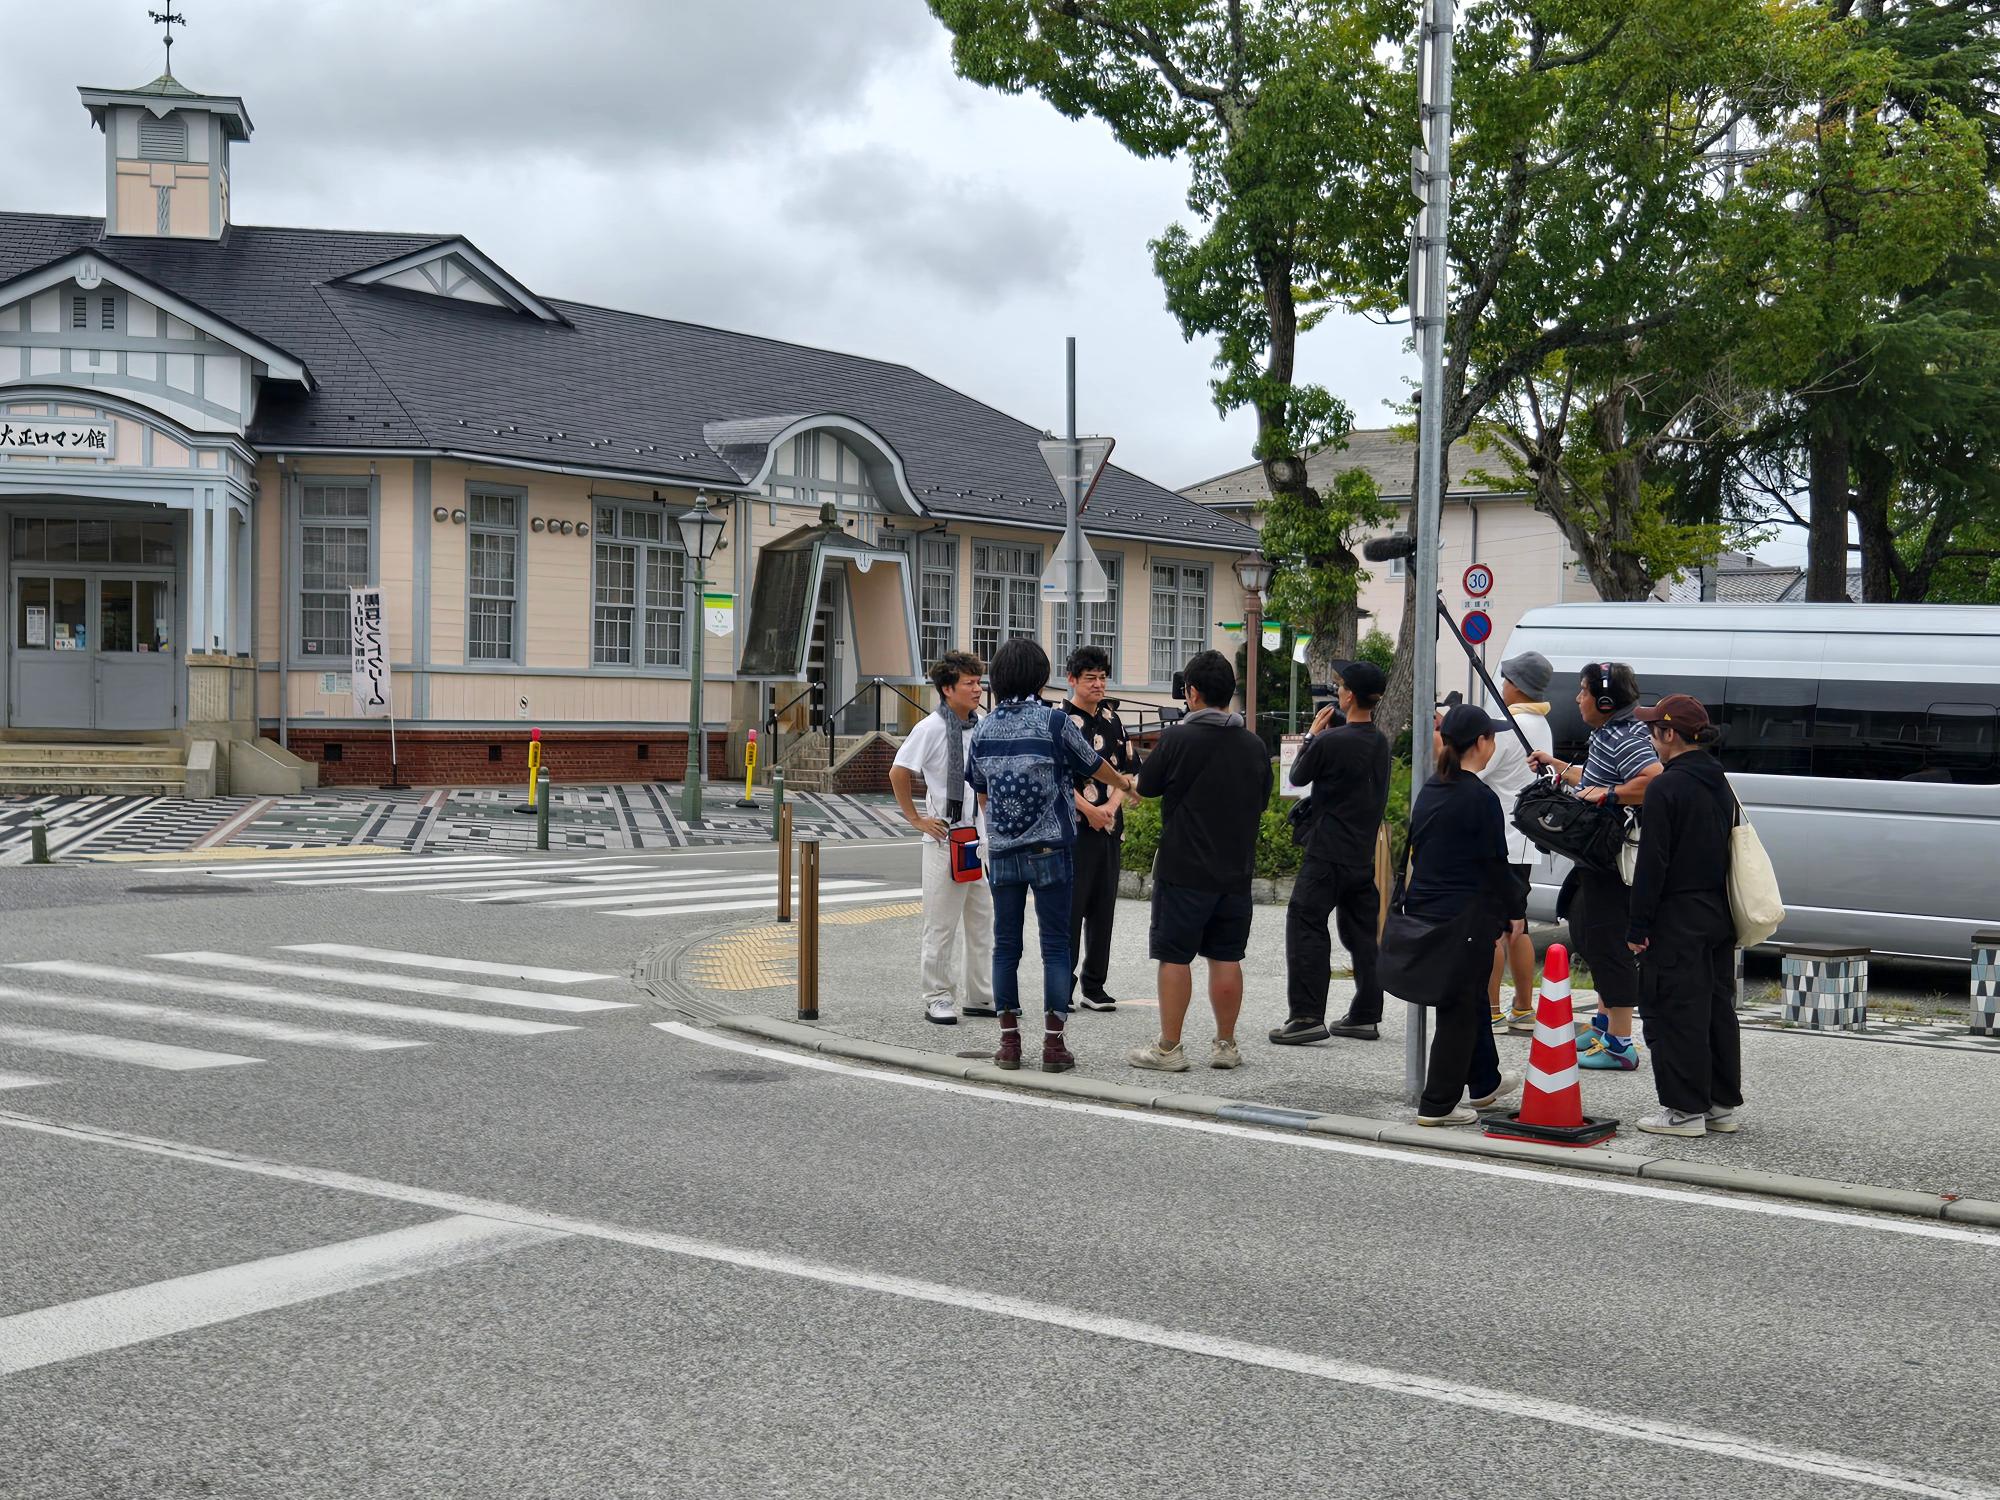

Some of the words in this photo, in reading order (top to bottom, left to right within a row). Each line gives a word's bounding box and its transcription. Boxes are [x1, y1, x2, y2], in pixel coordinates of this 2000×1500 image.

[0, 423, 107, 449] 大正ロマン館
[1469, 573, 1487, 589] 30
